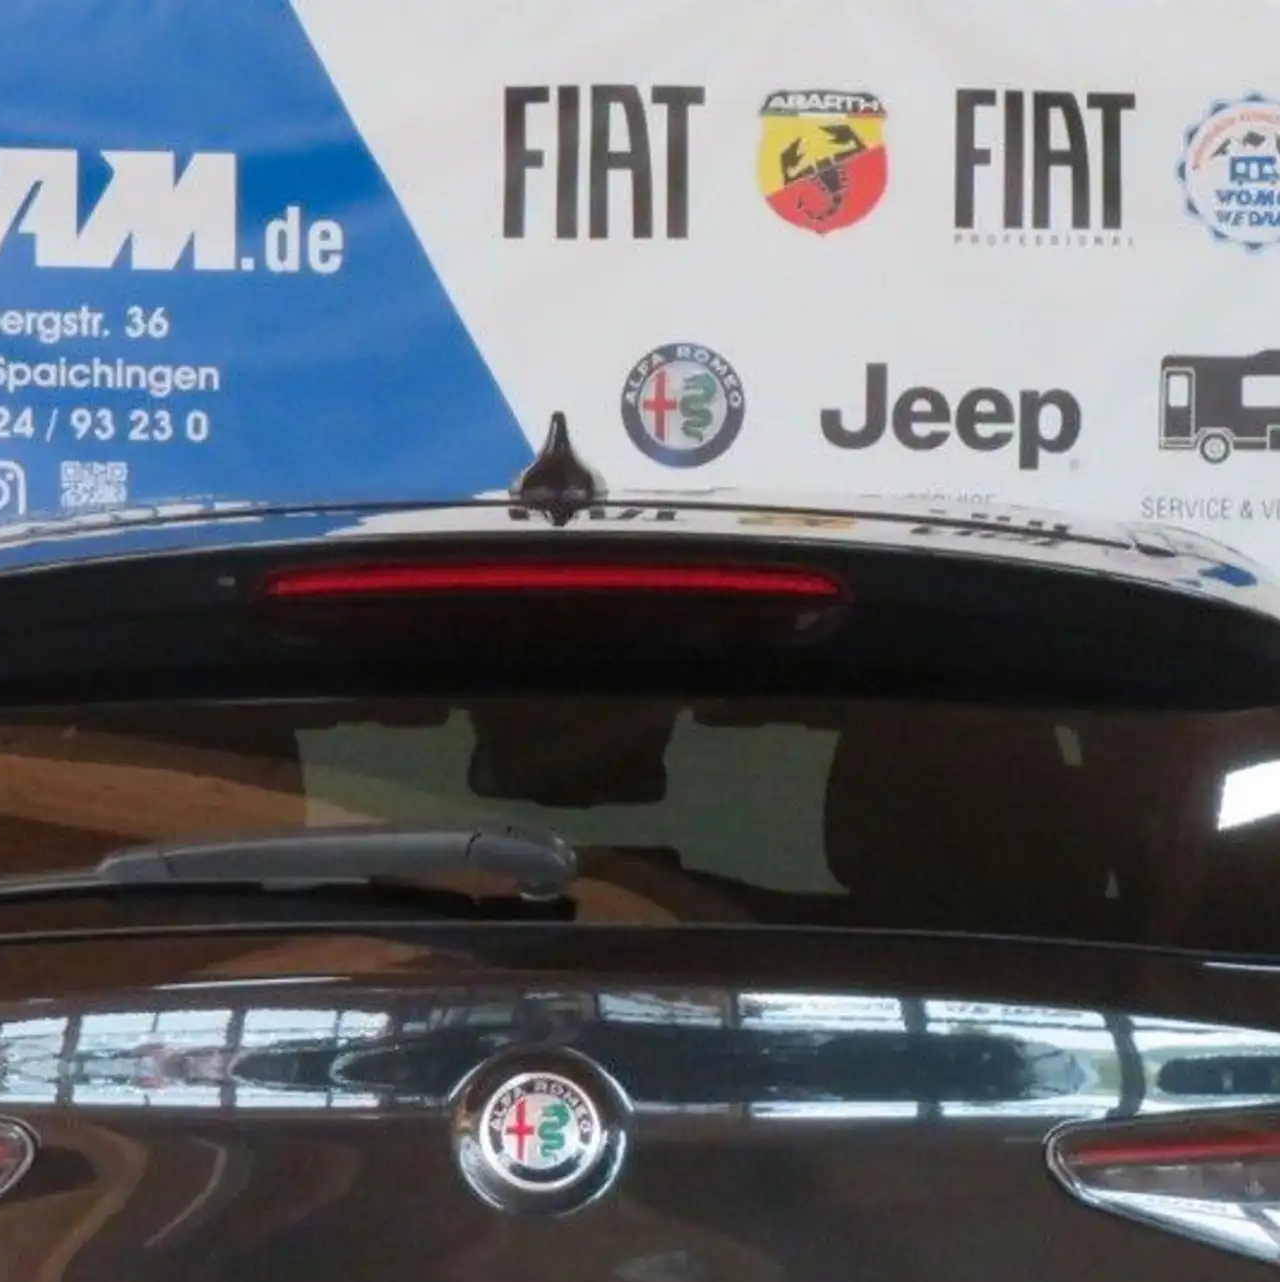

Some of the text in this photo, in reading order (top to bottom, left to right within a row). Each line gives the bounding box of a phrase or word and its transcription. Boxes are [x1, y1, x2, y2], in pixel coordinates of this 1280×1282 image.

[769, 92, 878, 112] ABARTH
[502, 83, 705, 239] FIAT
[954, 88, 1136, 229] FIAT
[125, 306, 170, 338] 36
[625, 346, 743, 408] ALFA ROMEO
[45, 408, 59, 443] /
[70, 408, 116, 440] 93
[128, 410, 173, 441] 23
[186, 411, 209, 441] 0
[819, 362, 1082, 470] Jeep
[1141, 497, 1231, 520] SERVICE
[1239, 498, 1253, 520] &
